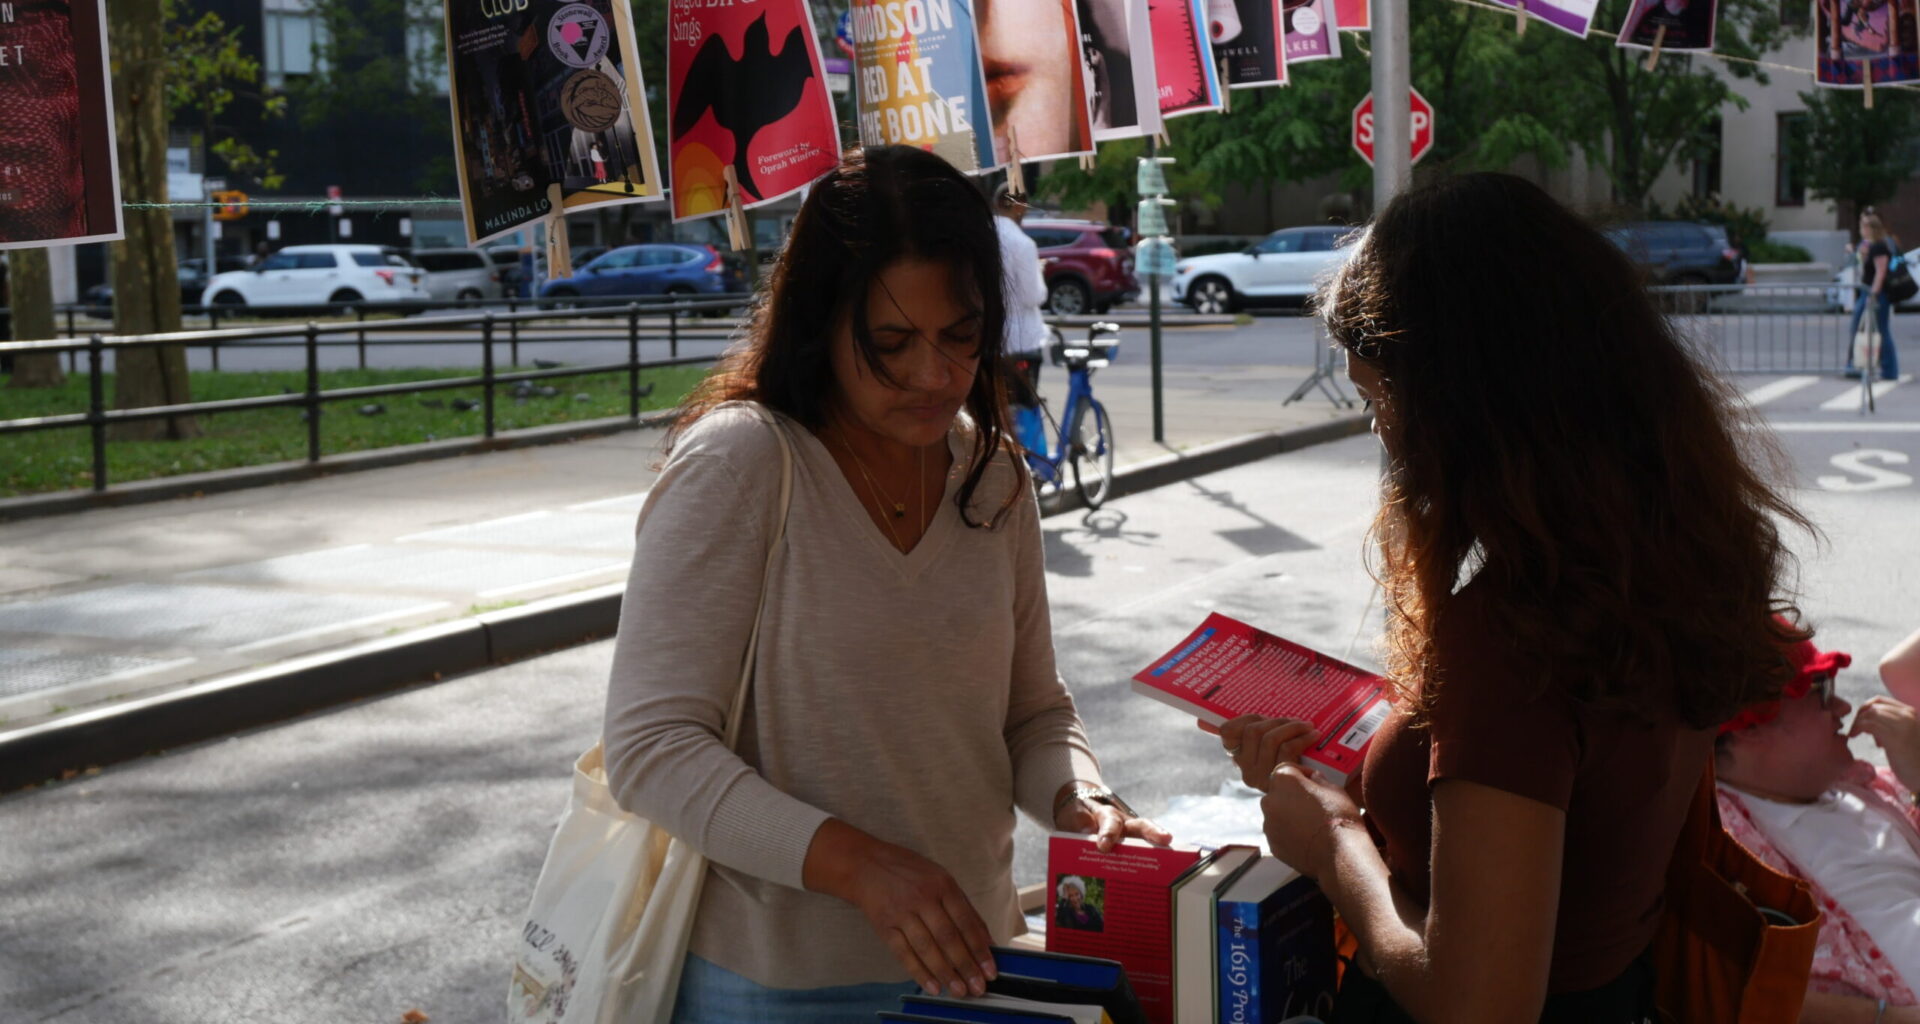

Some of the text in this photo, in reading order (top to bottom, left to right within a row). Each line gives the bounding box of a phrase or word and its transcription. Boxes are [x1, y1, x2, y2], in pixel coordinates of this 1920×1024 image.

[673, 13, 702, 47] Sings
[863, 57, 933, 104] RED AT
[886, 95, 968, 143] BONE
[1360, 112, 1428, 144] SP
[758, 145, 798, 164] Foreword
[761, 160, 787, 175] Oprah
[484, 198, 549, 230] MALINDA LO
[1228, 917, 1251, 1024] The 1619 Pro
